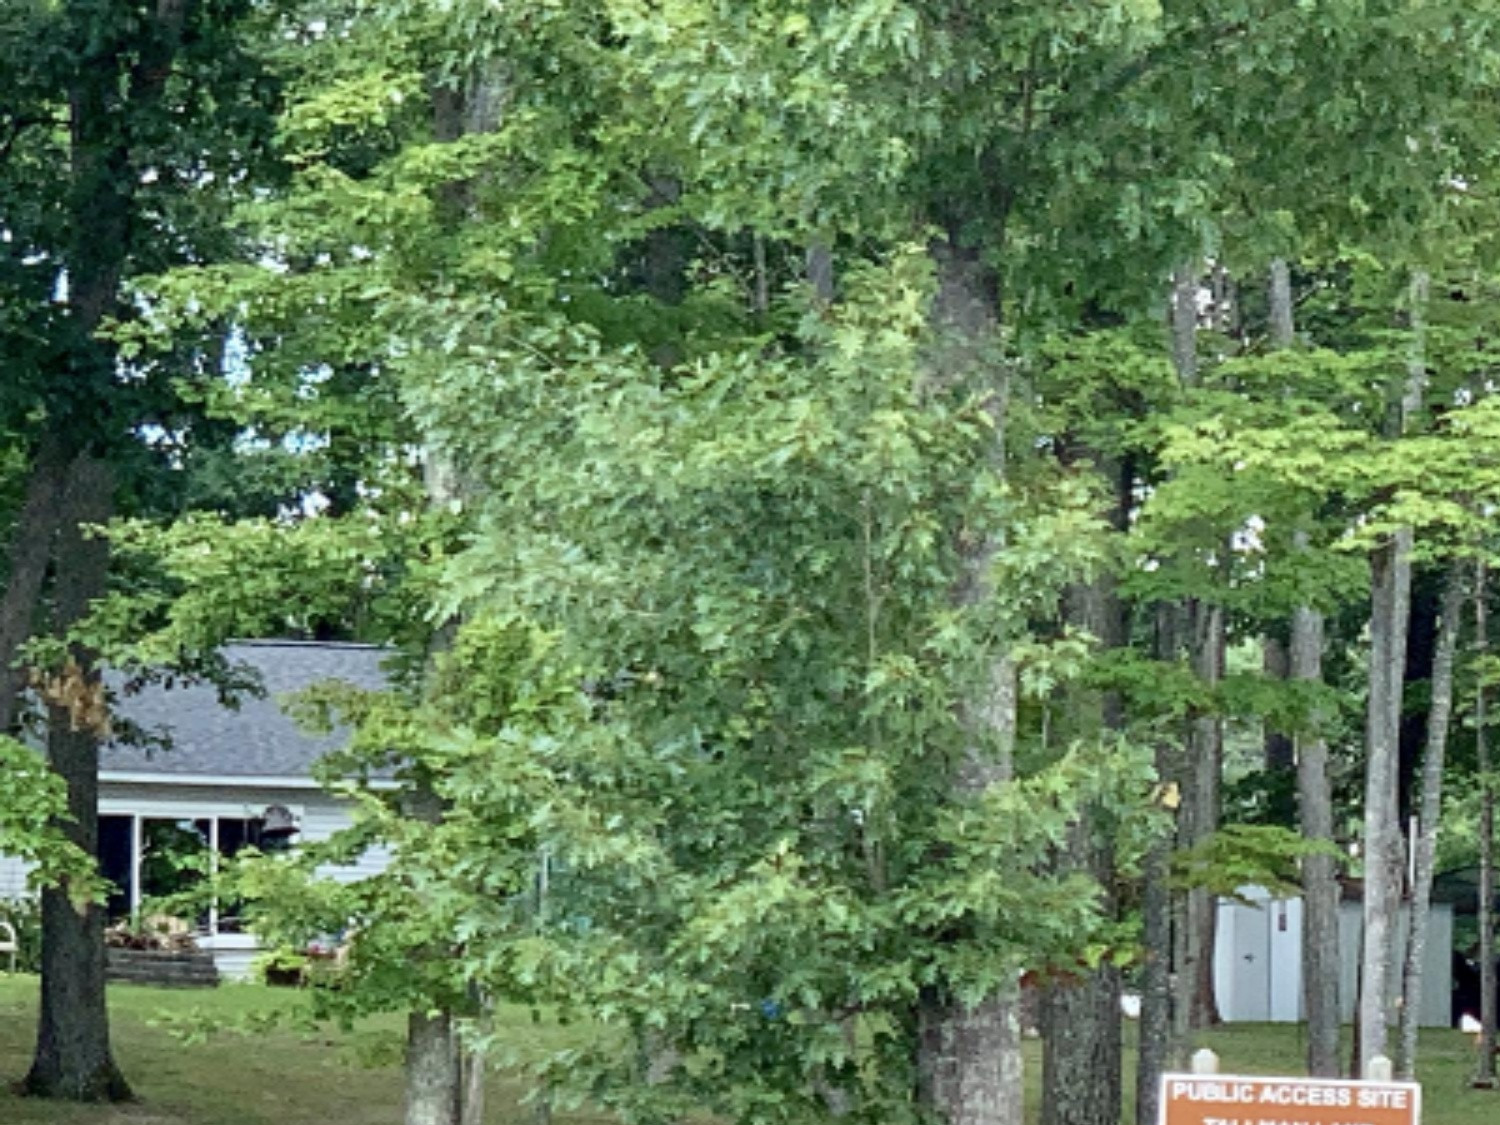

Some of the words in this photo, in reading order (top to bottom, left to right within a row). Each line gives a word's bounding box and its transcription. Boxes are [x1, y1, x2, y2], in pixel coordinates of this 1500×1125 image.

[1172, 1082, 1254, 1104] PUBLIC
[1259, 1085, 1351, 1107] ACCESS
[1357, 1088, 1408, 1109] SITE
